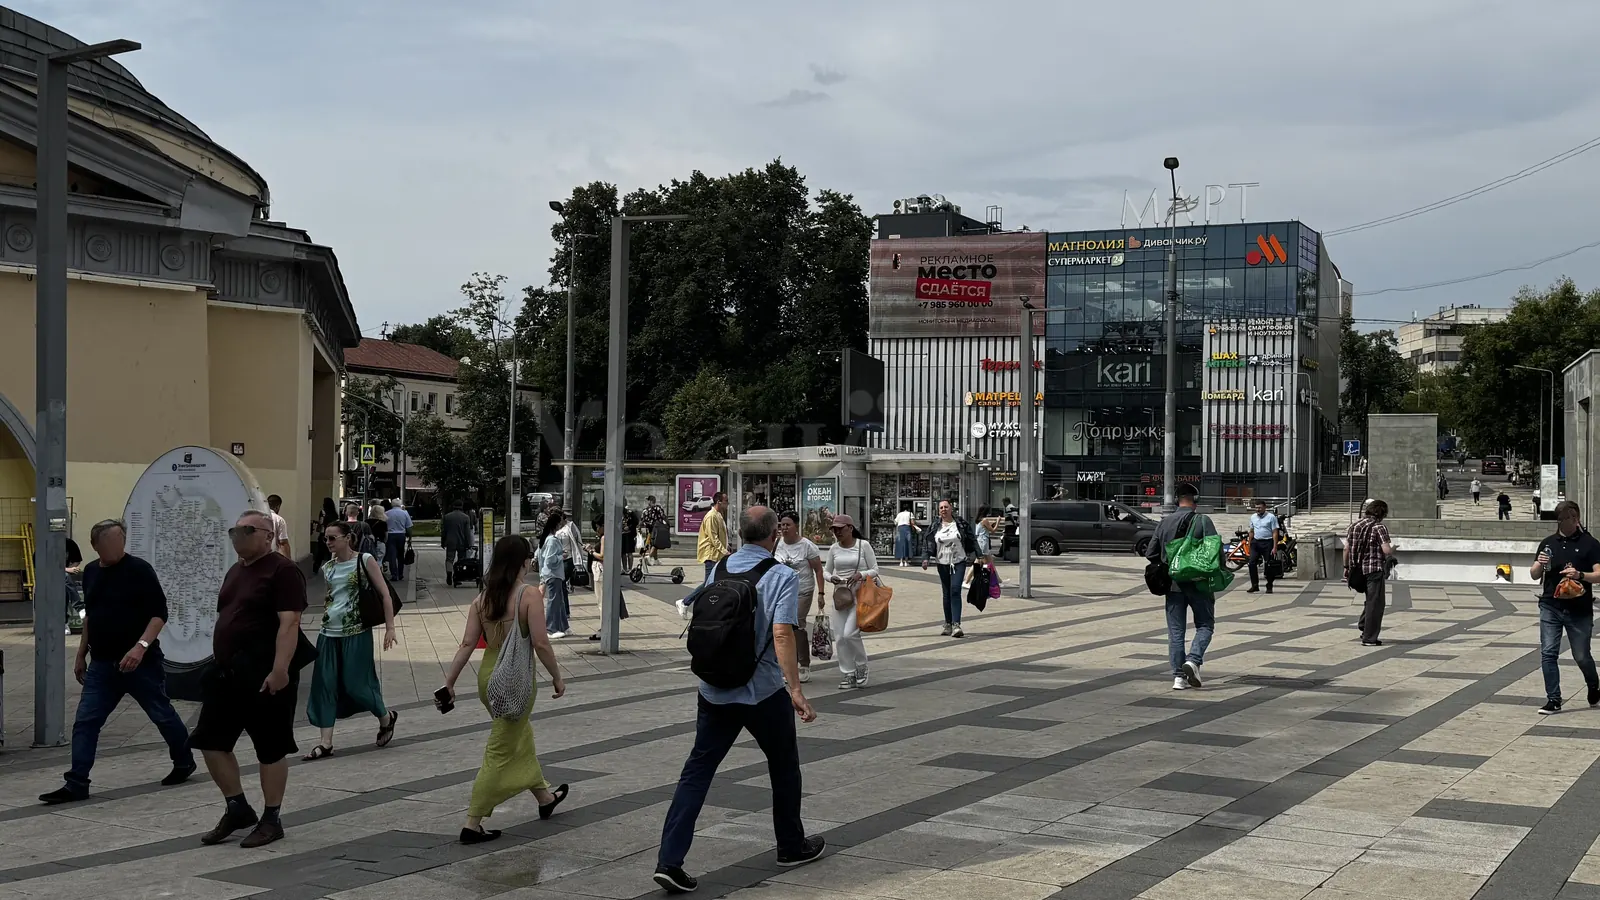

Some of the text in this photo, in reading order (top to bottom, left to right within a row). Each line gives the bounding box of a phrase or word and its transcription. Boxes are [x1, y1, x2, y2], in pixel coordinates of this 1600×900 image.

[1121, 182, 1260, 226] МАРТ
[1048, 240, 1124, 251] МАГНОЛИЯ
[920, 254, 994, 265] РЕКЛАМНОЕ
[1048, 255, 1112, 266] СУПЕРМАРКЕТ
[920, 282, 986, 296] СДАЁТСЯ
[1097, 356, 1150, 383] kari
[1253, 386, 1283, 401] kari
